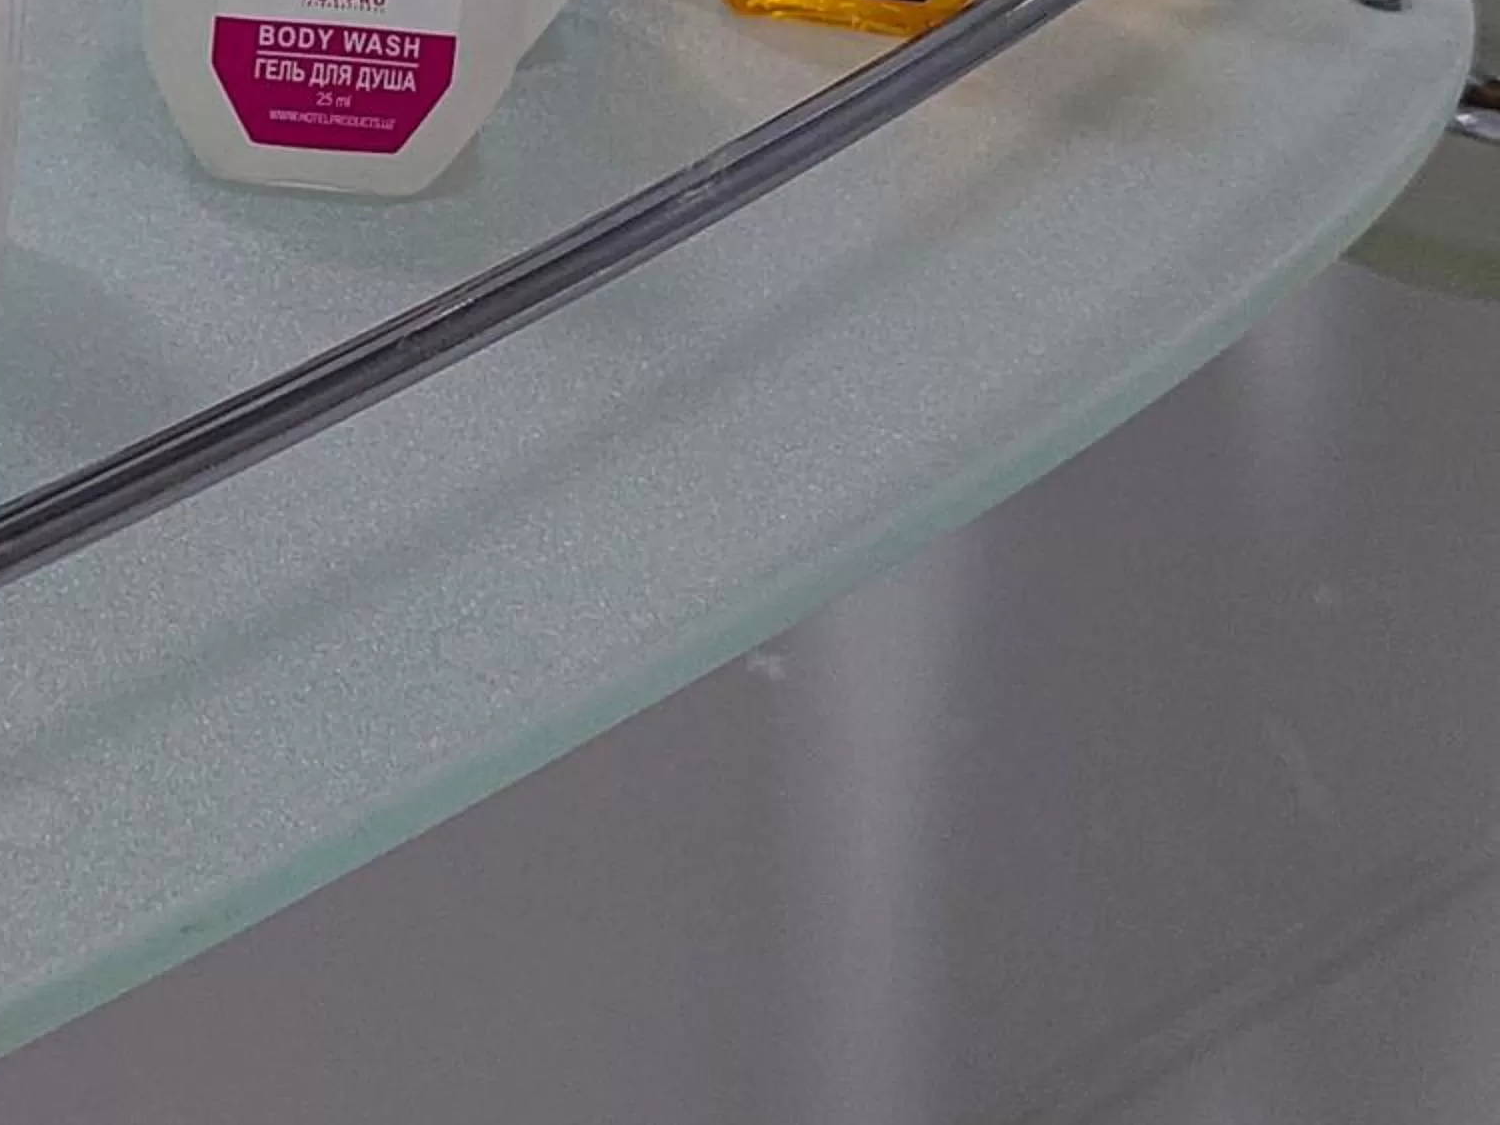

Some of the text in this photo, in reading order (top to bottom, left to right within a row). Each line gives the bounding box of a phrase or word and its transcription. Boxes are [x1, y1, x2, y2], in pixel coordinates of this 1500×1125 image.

[258, 24, 422, 59] BODY WASH
[254, 58, 417, 93] ГЕЛЬ ДЛЯ ДУША
[315, 91, 353, 108] 25 ml
